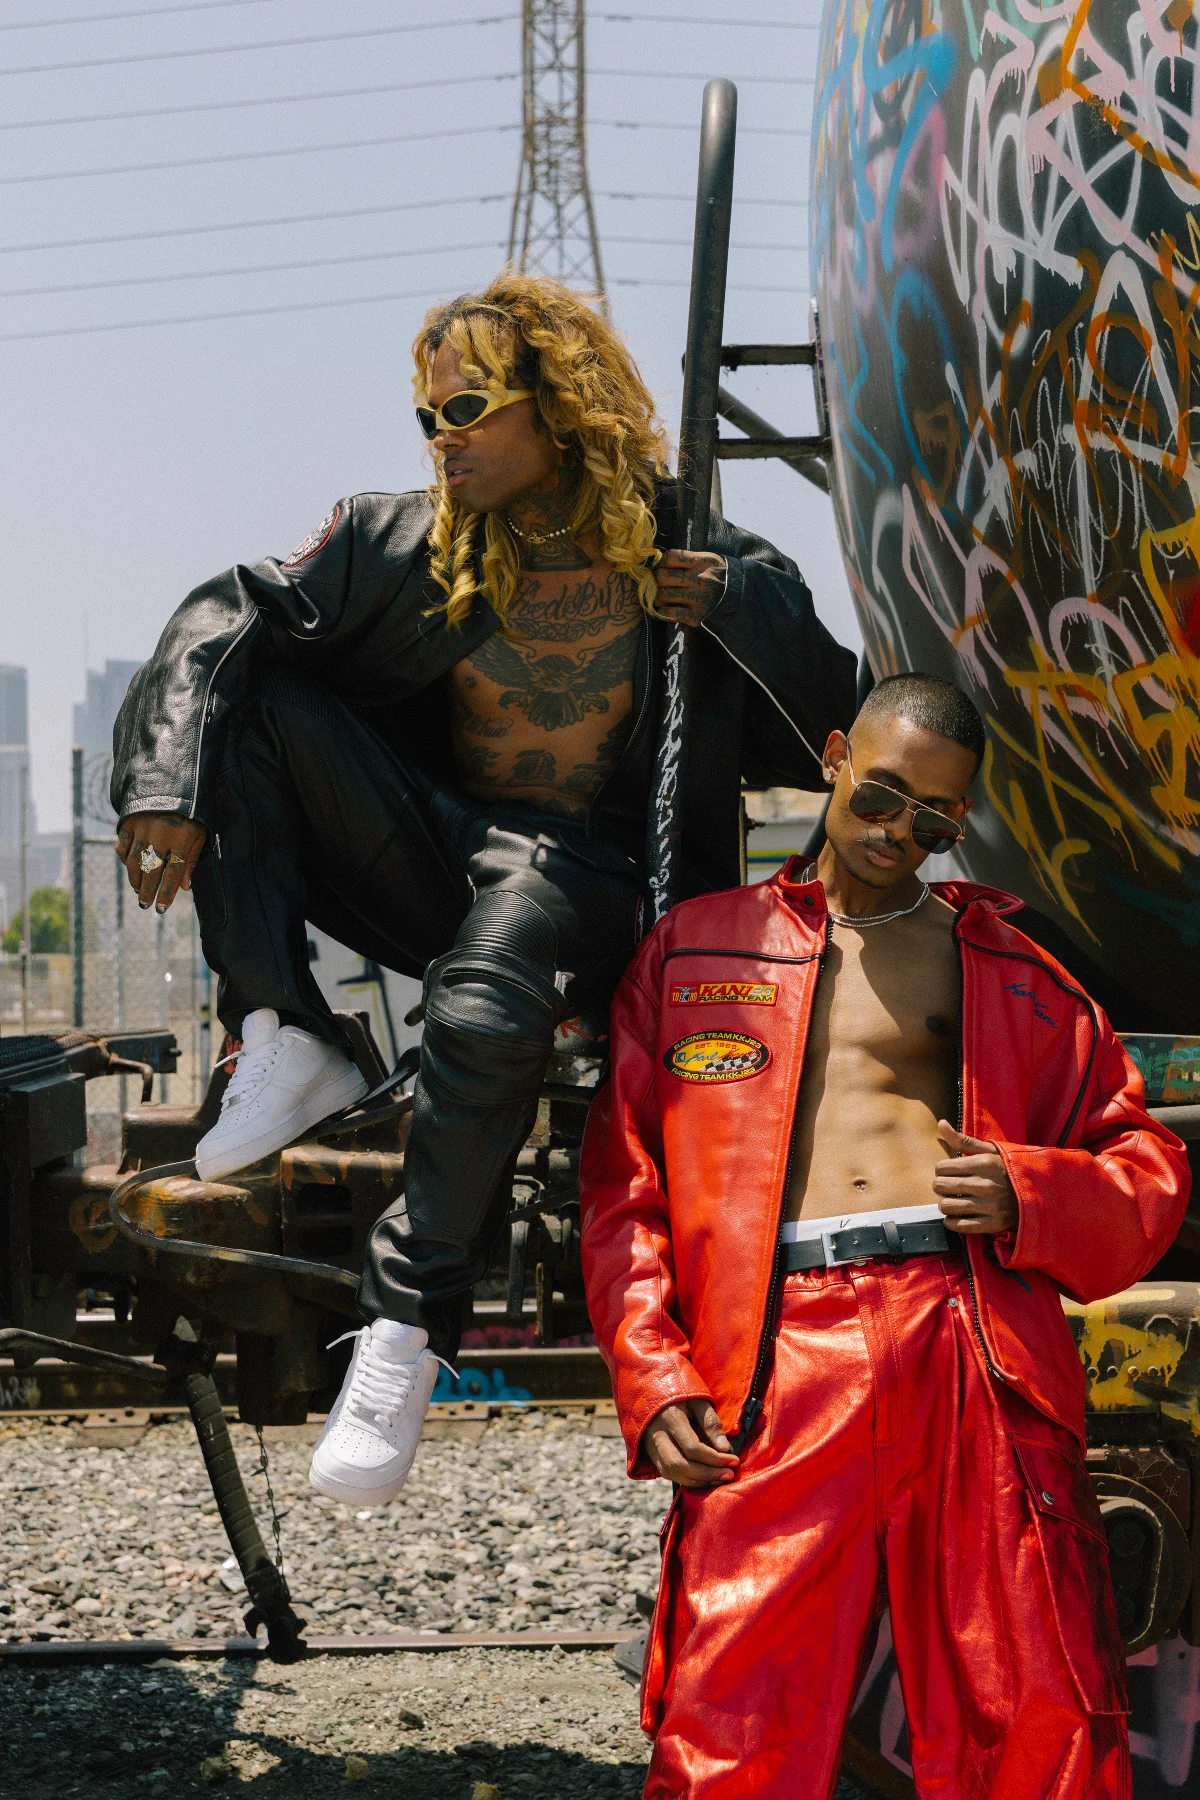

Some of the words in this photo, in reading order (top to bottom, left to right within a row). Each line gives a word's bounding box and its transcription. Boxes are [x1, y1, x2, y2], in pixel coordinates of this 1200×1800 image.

[673, 1033, 706, 1050] RACING
[733, 1033, 762, 1049] KKJ23
[671, 1067, 699, 1080] RACING
